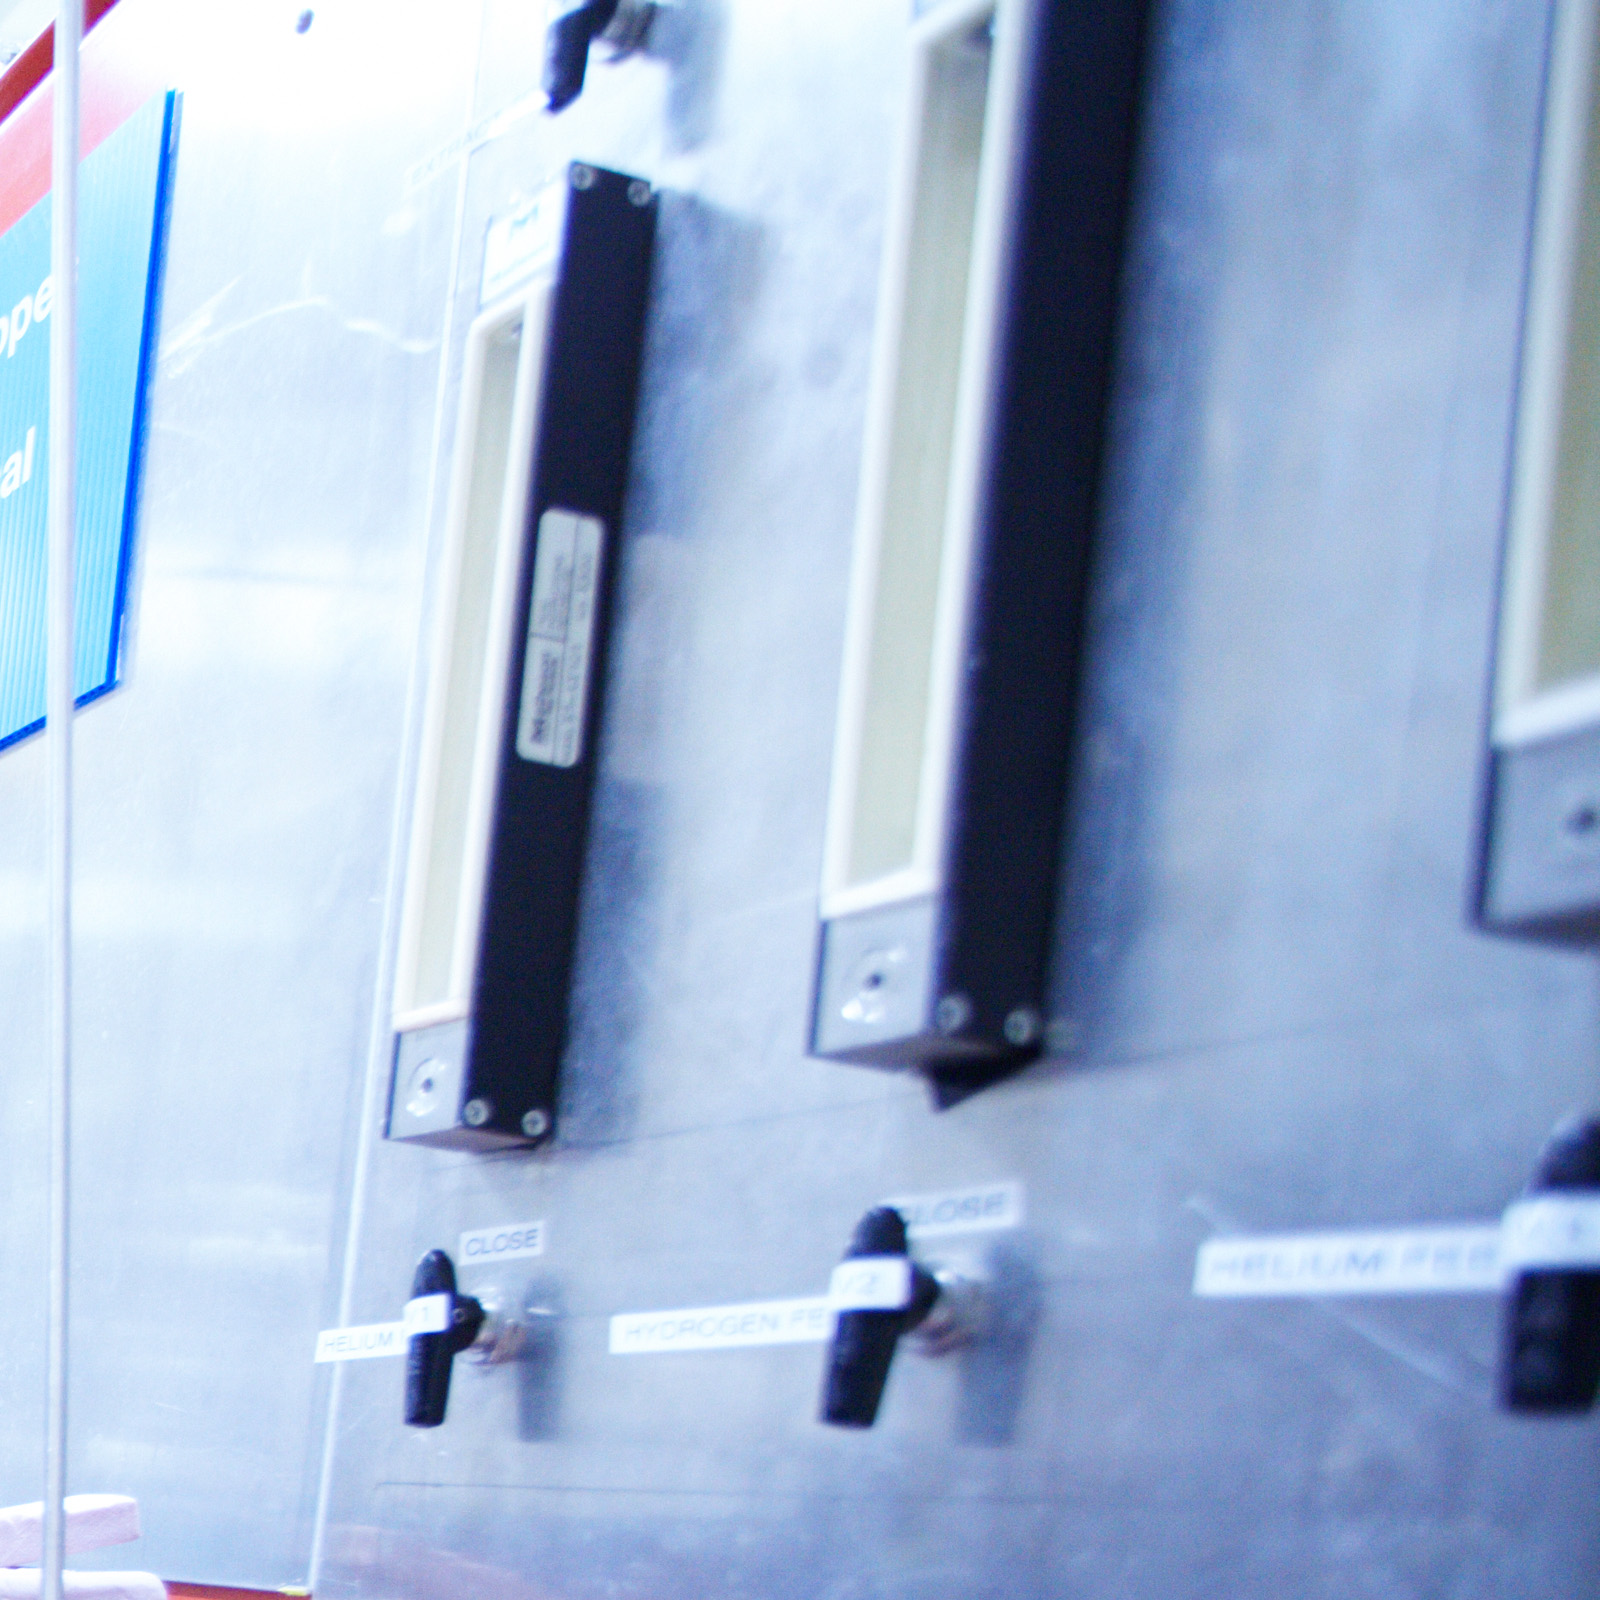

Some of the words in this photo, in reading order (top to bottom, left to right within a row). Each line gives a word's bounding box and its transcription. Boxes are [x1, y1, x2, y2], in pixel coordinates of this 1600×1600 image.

[464, 1228, 539, 1257] CLOSE
[624, 1312, 779, 1342] HYDROGEN
[323, 1331, 394, 1353] HELIUM
